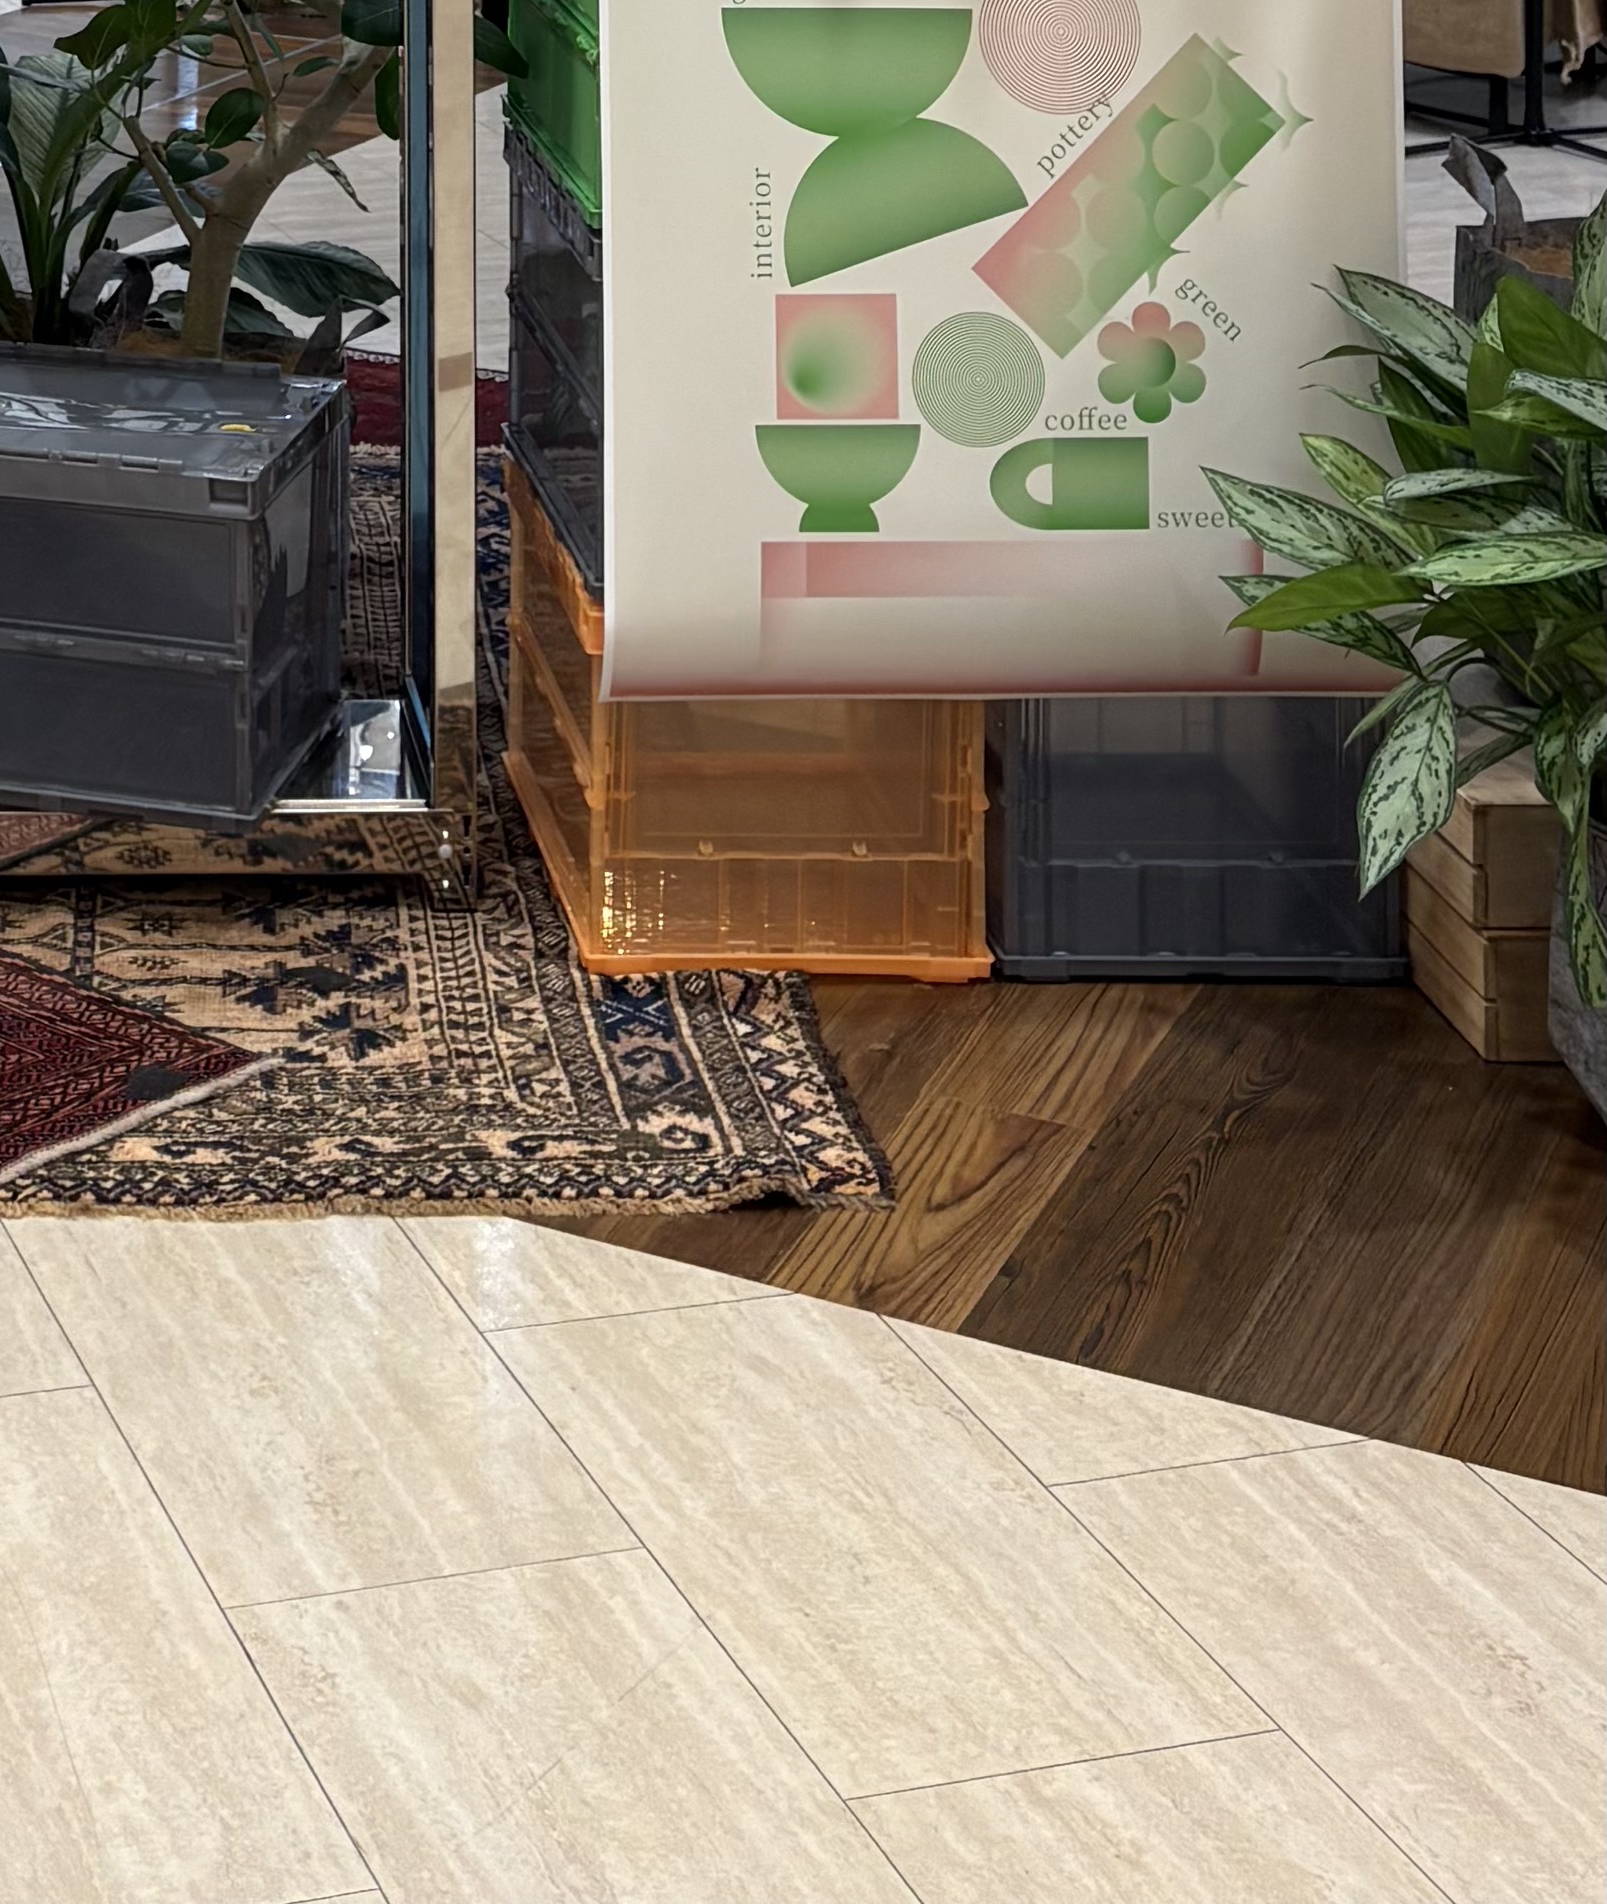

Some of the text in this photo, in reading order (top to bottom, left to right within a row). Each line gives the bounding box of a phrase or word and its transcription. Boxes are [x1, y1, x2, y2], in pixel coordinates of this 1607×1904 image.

[1036, 92, 1116, 178] pottery
[749, 166, 774, 280] interior
[1175, 274, 1243, 343] green
[1044, 408, 1129, 433] coffee
